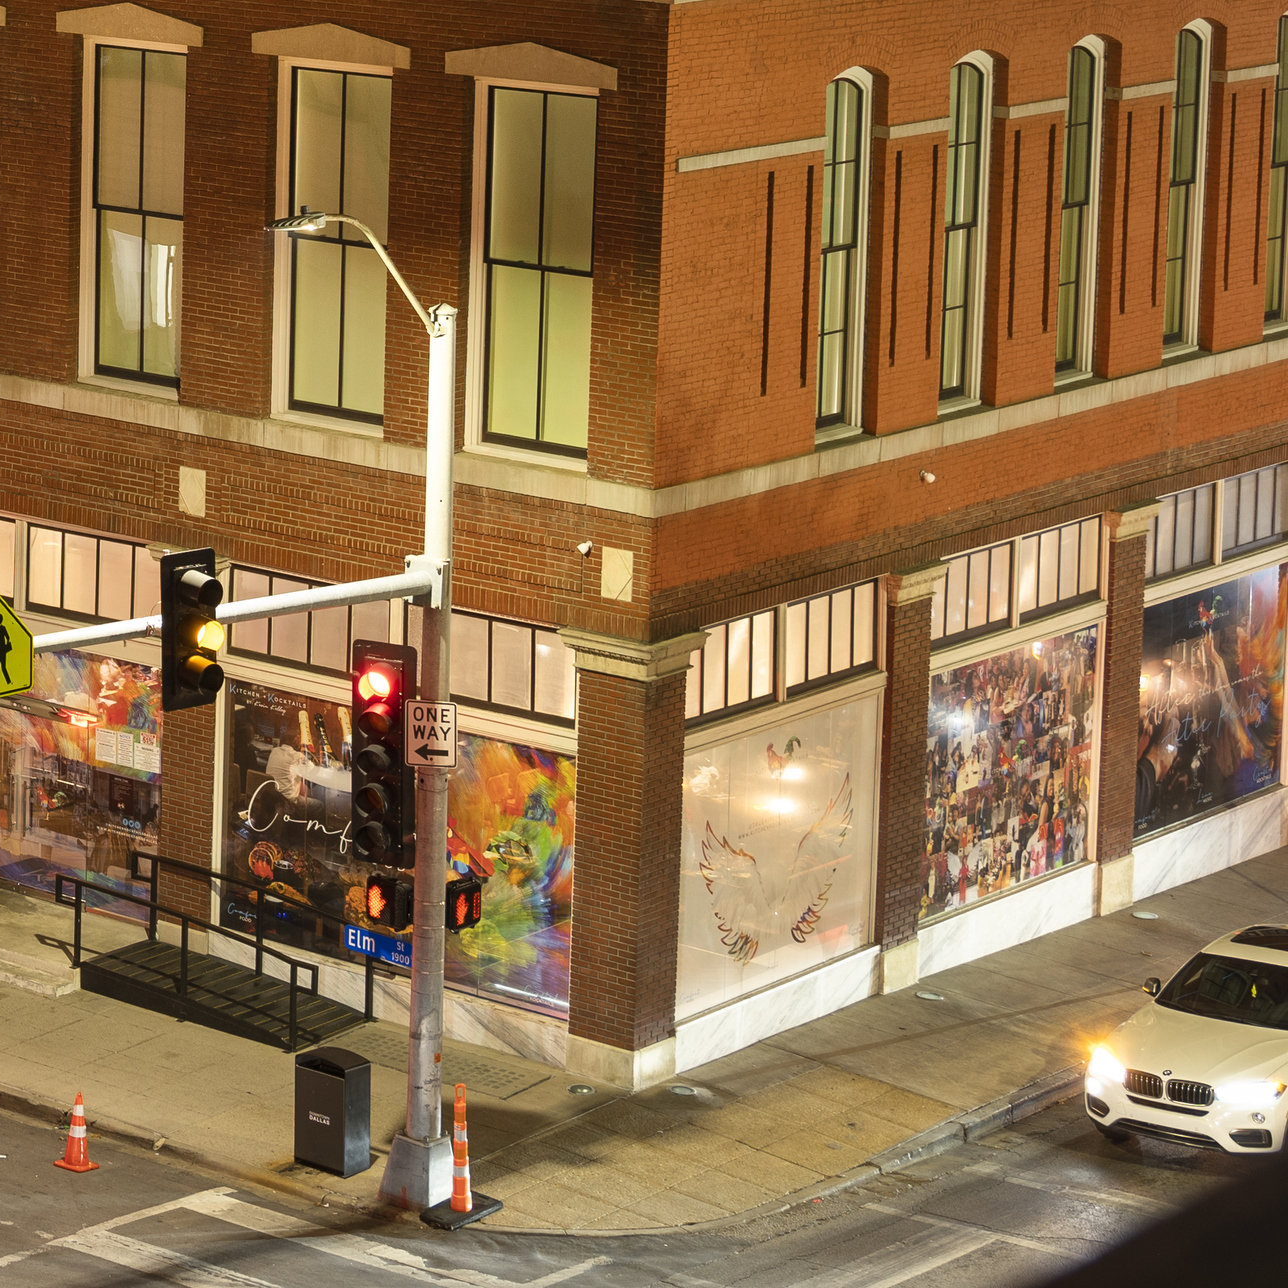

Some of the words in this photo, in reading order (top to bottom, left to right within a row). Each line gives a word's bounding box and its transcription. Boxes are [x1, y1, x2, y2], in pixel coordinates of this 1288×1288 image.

[229, 683, 260, 699] KITCHEN
[267, 692, 307, 709] KOCKTAILS
[413, 706, 451, 724] ONE
[412, 724, 452, 741] WAY
[248, 779, 352, 854] Comf
[348, 928, 375, 953] Elm
[396, 941, 405, 952] St
[391, 952, 410, 965] 1900
[308, 1114, 331, 1126] DALLAS
